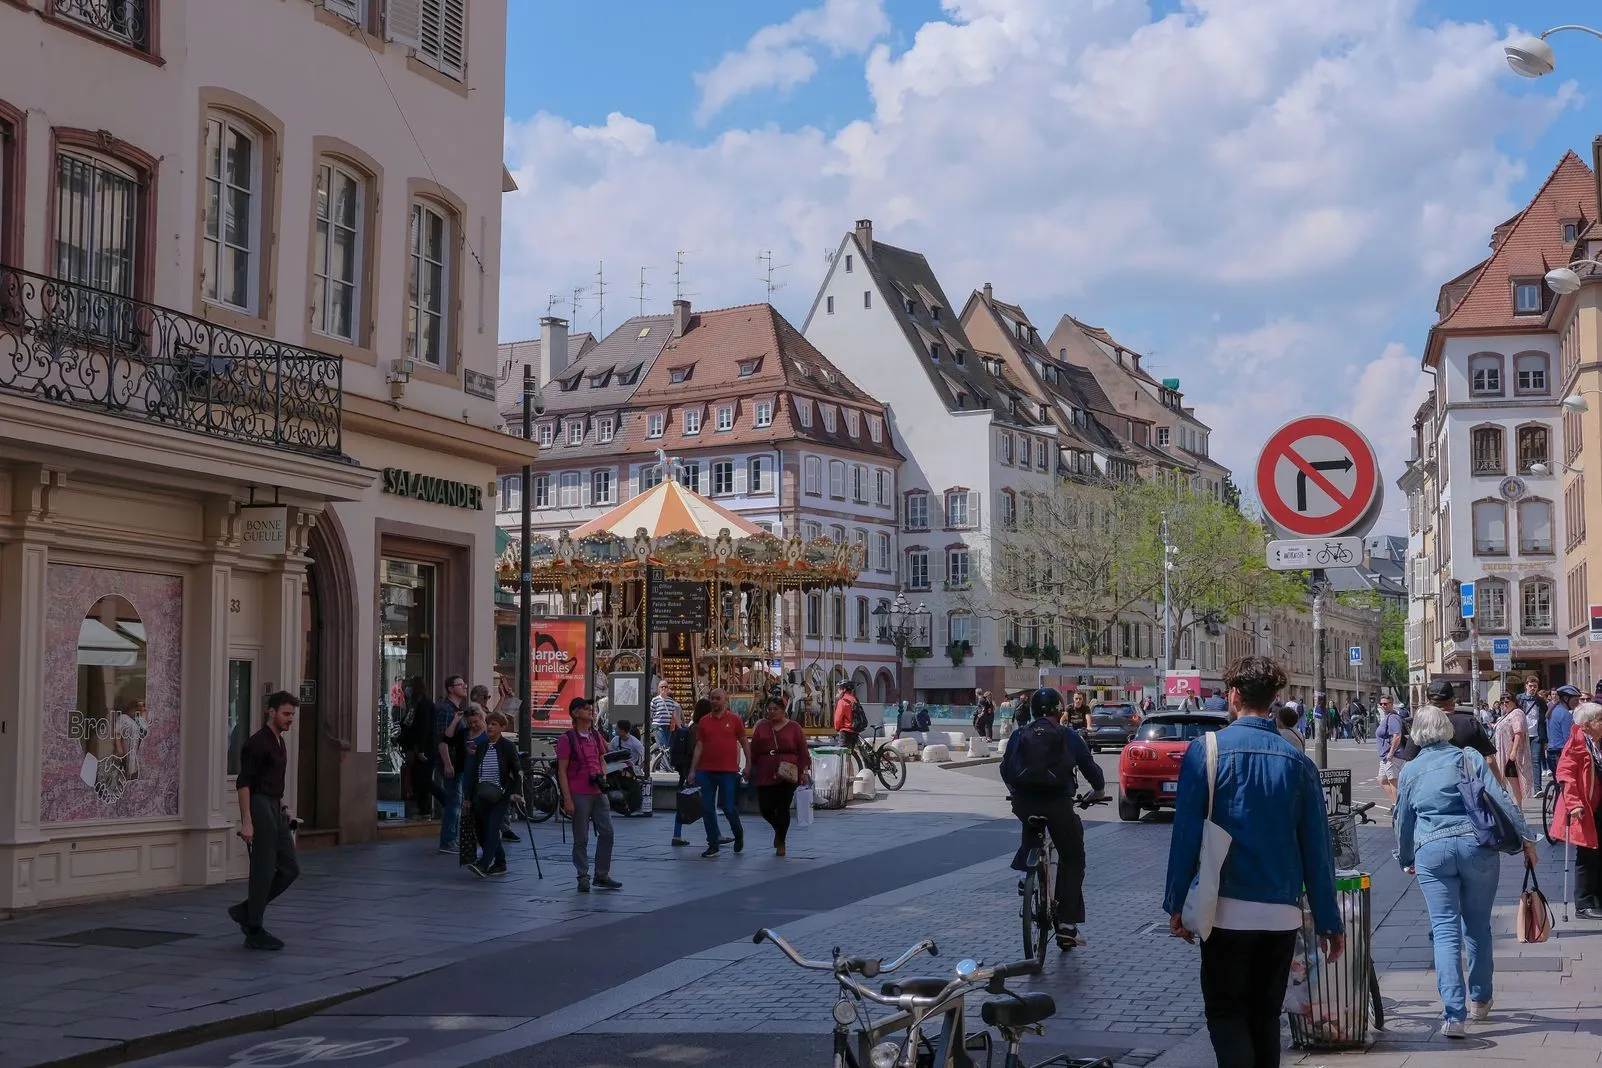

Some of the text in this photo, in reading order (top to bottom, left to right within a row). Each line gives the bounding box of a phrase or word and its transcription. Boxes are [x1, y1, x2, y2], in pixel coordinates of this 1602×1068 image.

[384, 468, 483, 511] SALAMANDER
[247, 520, 281, 531] BONNE
[244, 531, 283, 542] GUEULE
[1462, 595, 1473, 605] TAXIS
[230, 599, 241, 613] 33
[532, 661, 570, 673] lurielles
[1177, 679, 1189, 694] P
[1324, 770, 1350, 778] DESTOCKAGE
